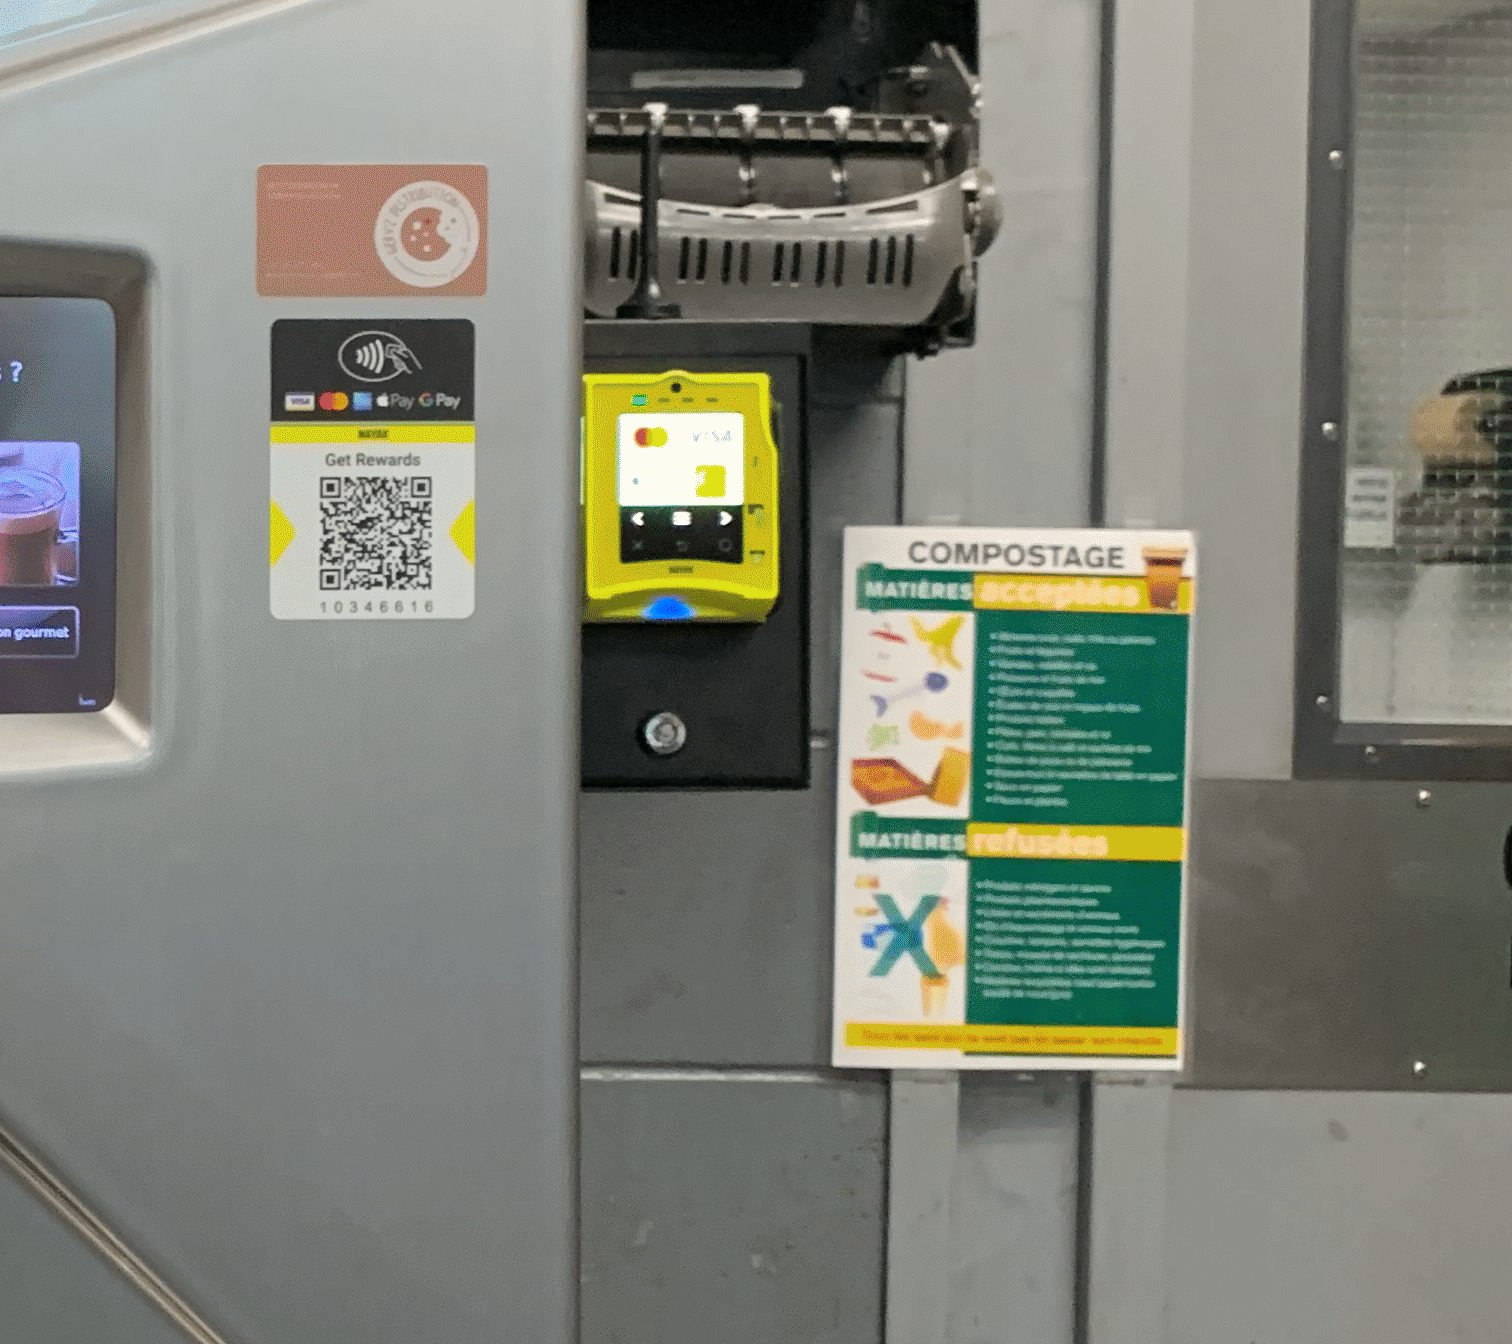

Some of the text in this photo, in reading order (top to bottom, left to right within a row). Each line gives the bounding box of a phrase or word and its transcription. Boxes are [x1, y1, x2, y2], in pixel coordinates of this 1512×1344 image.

[10, 359, 22, 382] ?
[389, 393, 414, 410] Pay
[435, 393, 461, 410] Pay
[325, 452, 422, 468] Get Rewards
[908, 540, 1125, 569] COMPOSTAGE
[864, 576, 972, 601] MATIÈRES
[13, 626, 69, 641] gourmet
[857, 828, 1109, 857] MATIÈRES refusées
